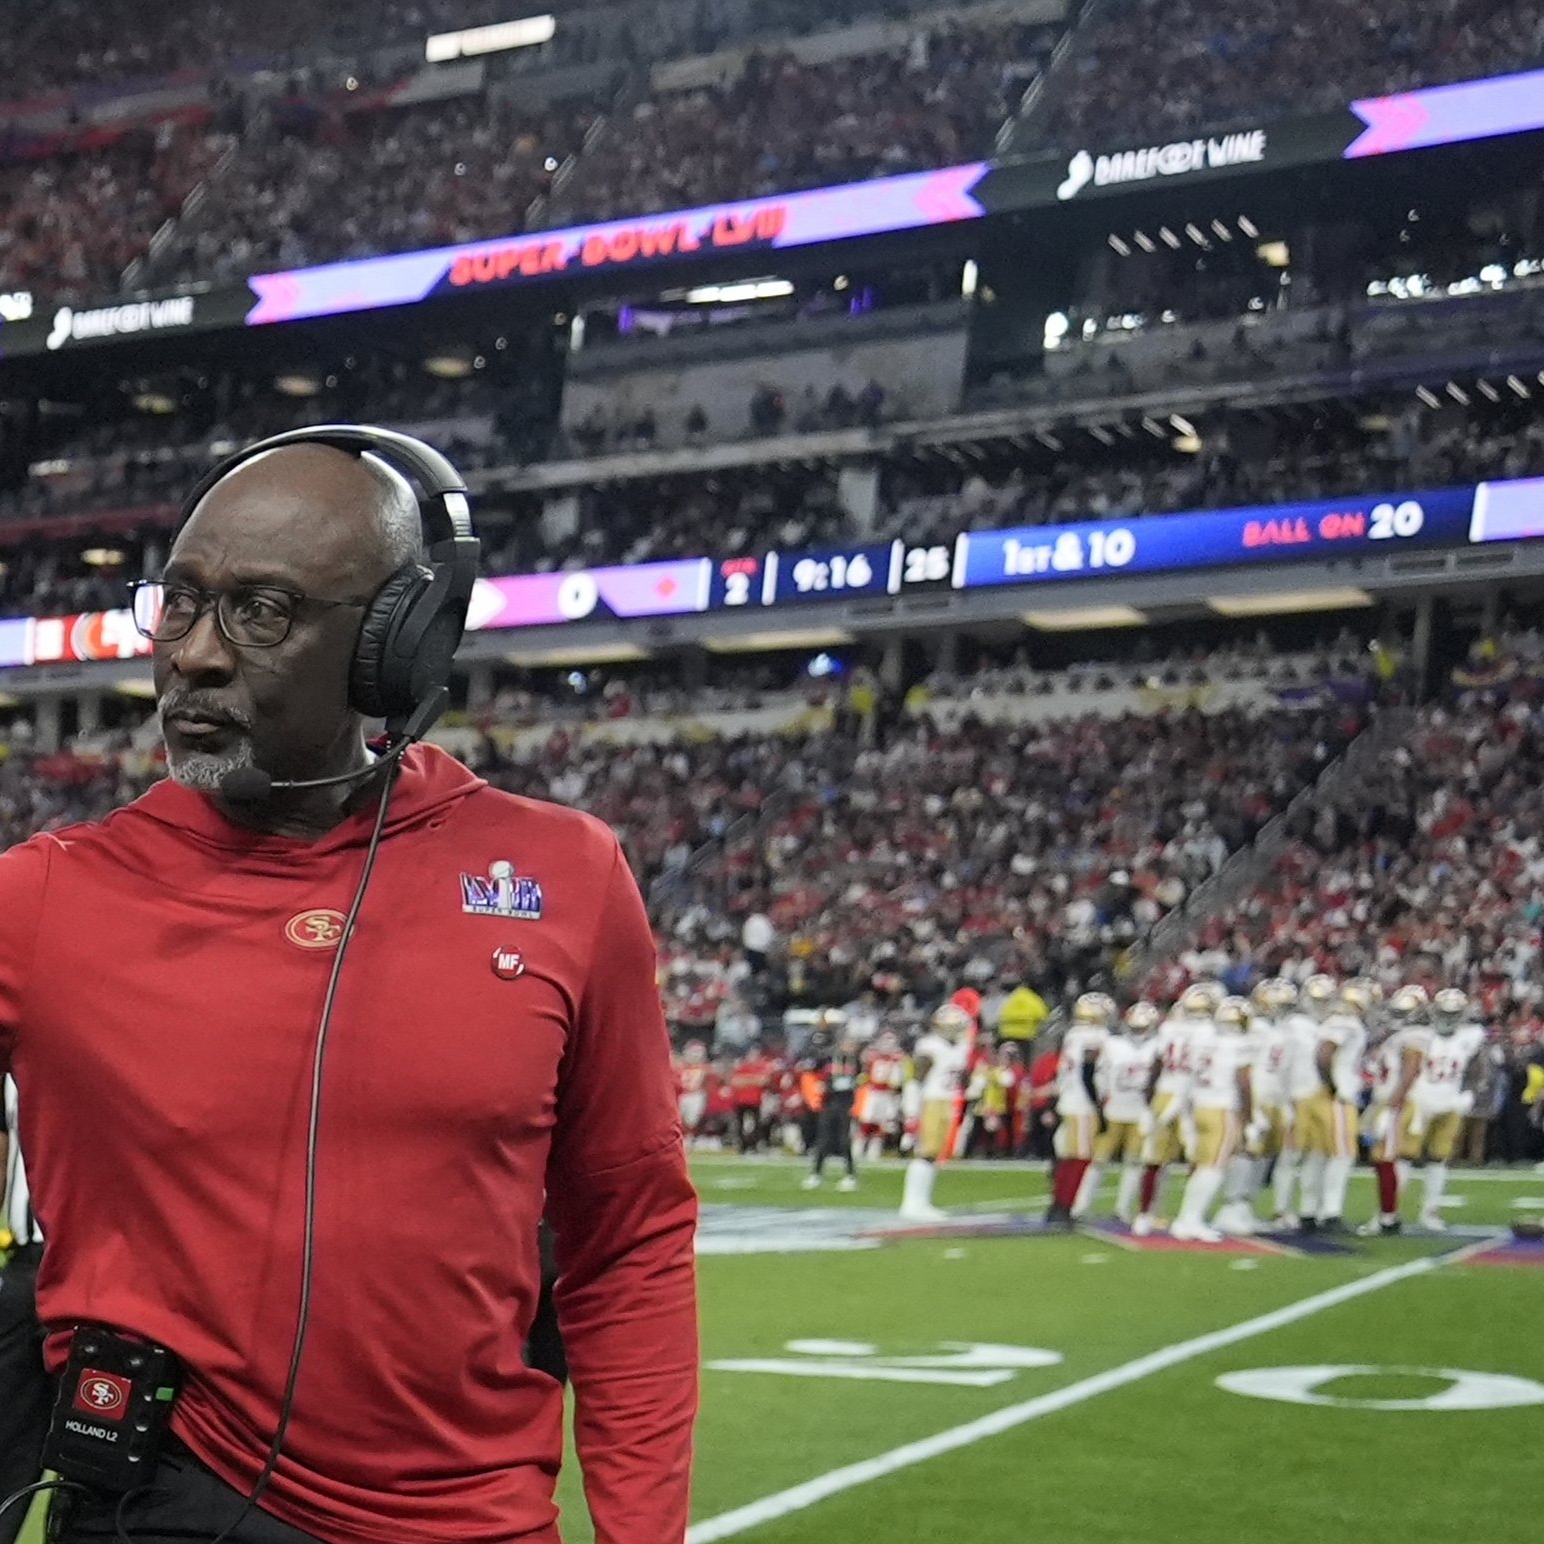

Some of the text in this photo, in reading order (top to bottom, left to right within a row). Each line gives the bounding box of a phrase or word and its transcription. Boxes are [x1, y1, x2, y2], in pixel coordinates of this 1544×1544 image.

[448, 242, 567, 286] SUPER
[580, 221, 700, 267] BOWL
[1088, 528, 1136, 568] 10
[1242, 516, 1311, 549] BALL
[1318, 511, 1366, 540] ON
[1368, 500, 1425, 541] 20
[725, 573, 750, 606] 2
[793, 554, 873, 594] 9:16
[497, 952, 520, 970] MF
[65, 1420, 119, 1443] HOLLAND L2
